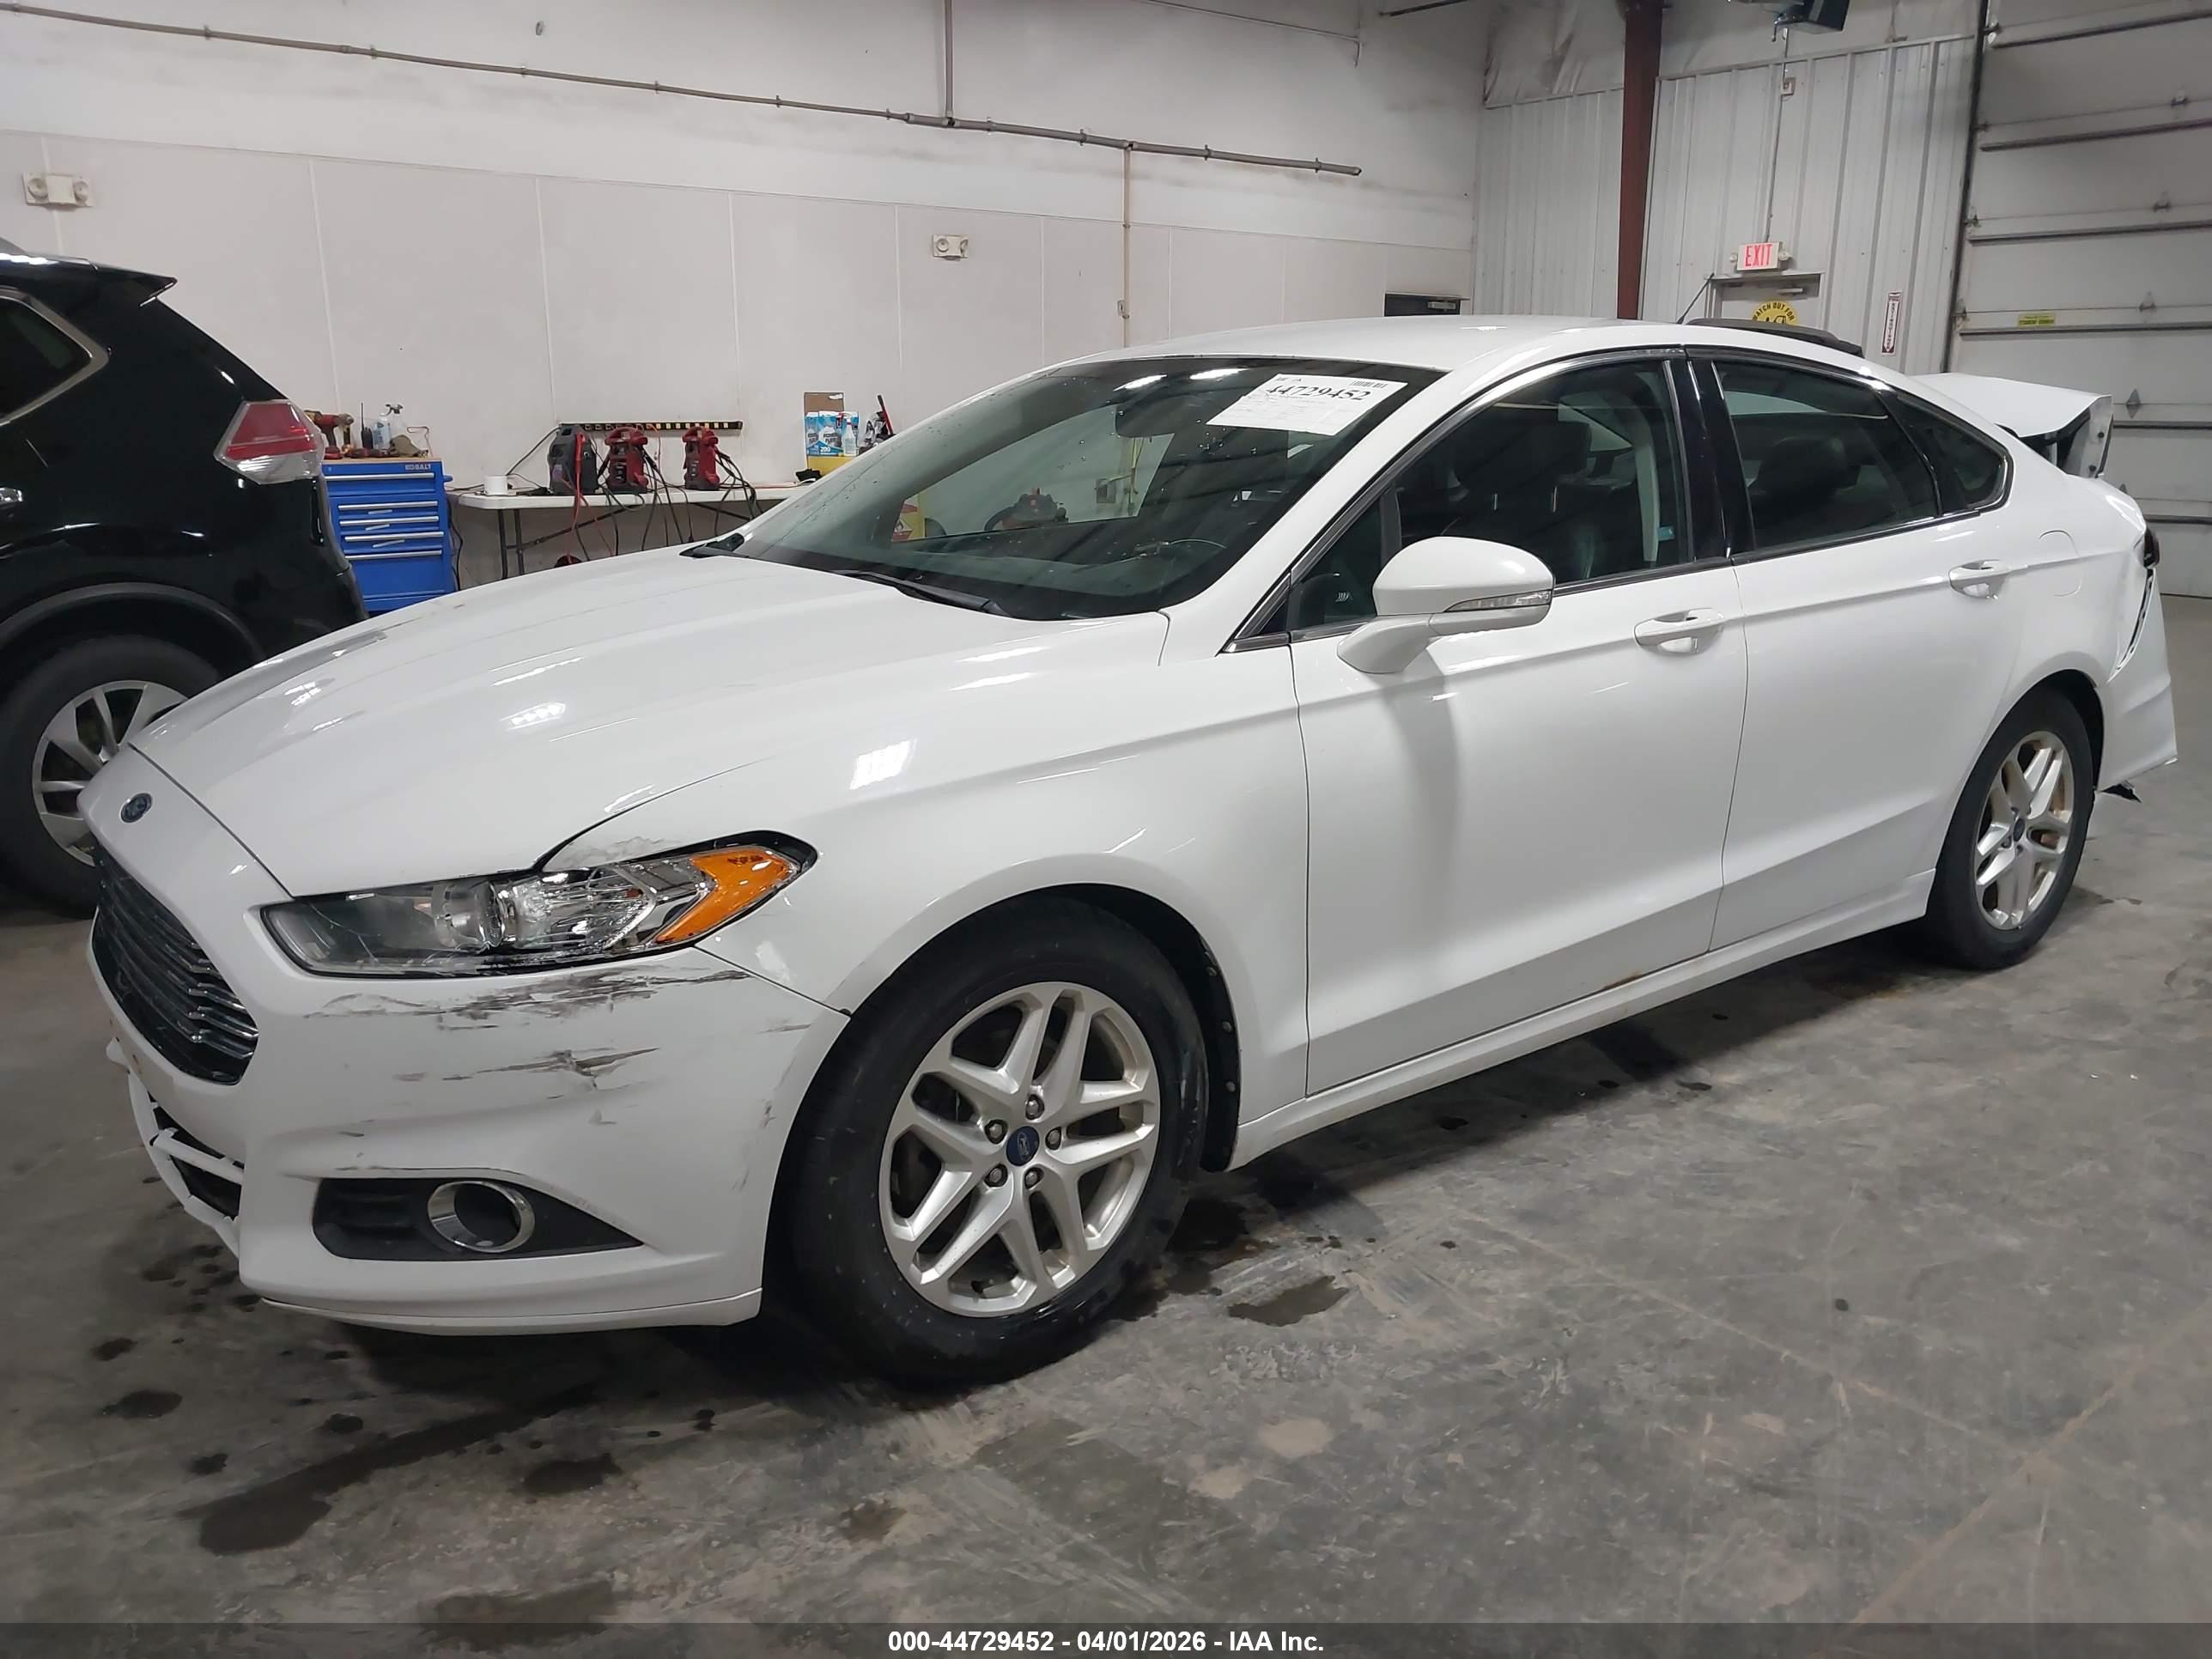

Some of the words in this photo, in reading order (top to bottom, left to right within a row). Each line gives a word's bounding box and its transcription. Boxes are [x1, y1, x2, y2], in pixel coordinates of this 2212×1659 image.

[1745, 243, 1773, 267] EXIT
[1753, 303, 1771, 322] WATCH
[1773, 301, 1785, 310] OUT
[1785, 307, 1795, 321] FOR
[1266, 385, 1371, 401] 44729452
